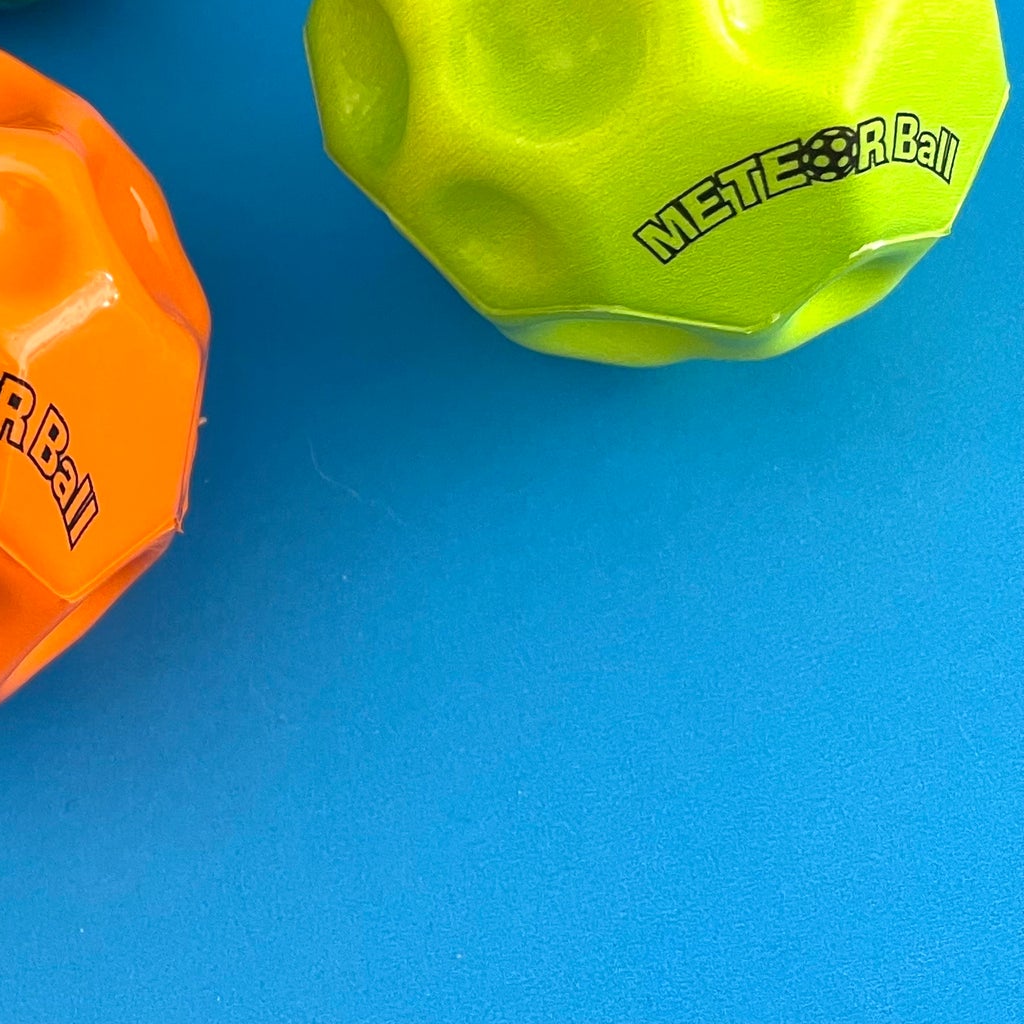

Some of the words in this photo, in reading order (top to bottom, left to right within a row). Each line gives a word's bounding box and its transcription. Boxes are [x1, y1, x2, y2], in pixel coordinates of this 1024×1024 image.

[633, 116, 889, 265] METEOR
[892, 112, 960, 185] Ball
[27, 403, 99, 551] Ball
